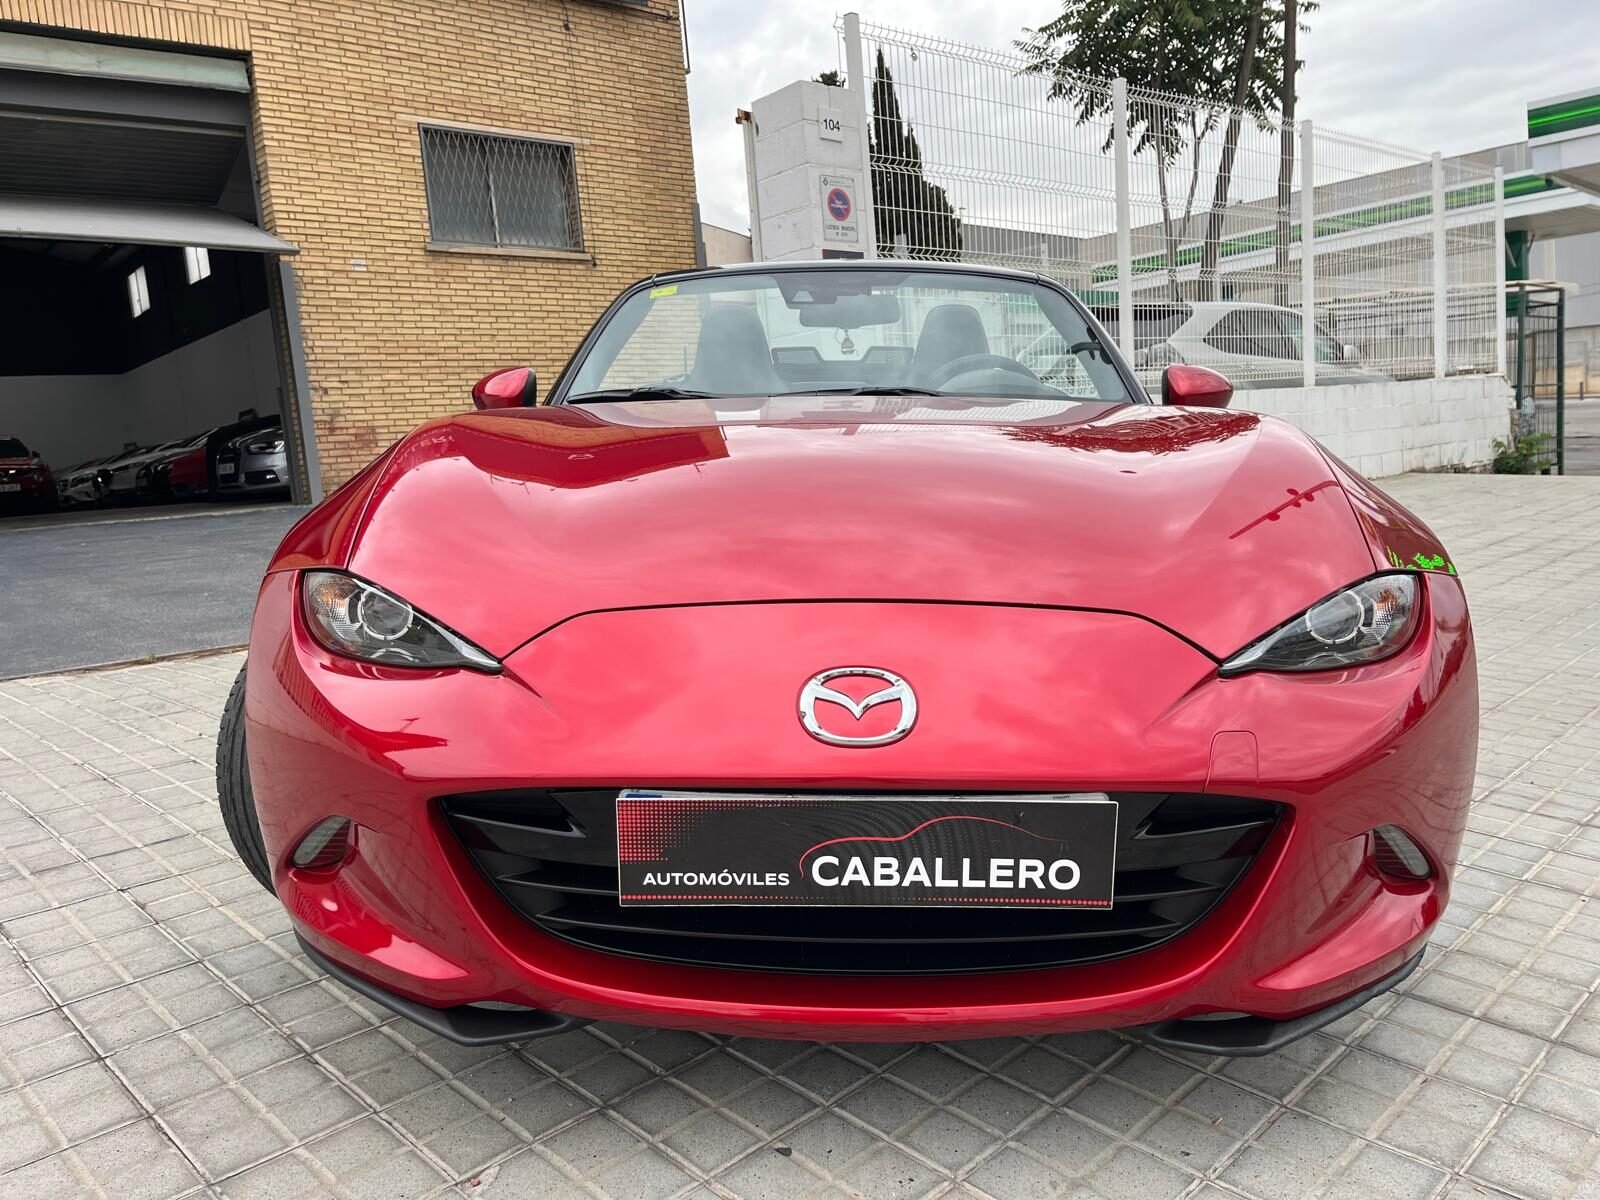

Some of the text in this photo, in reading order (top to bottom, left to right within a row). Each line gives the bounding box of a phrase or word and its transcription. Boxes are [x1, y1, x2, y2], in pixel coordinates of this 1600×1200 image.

[823, 118, 840, 132] 104
[642, 855, 1081, 891] AUTOMÓVILES CABALLERO
